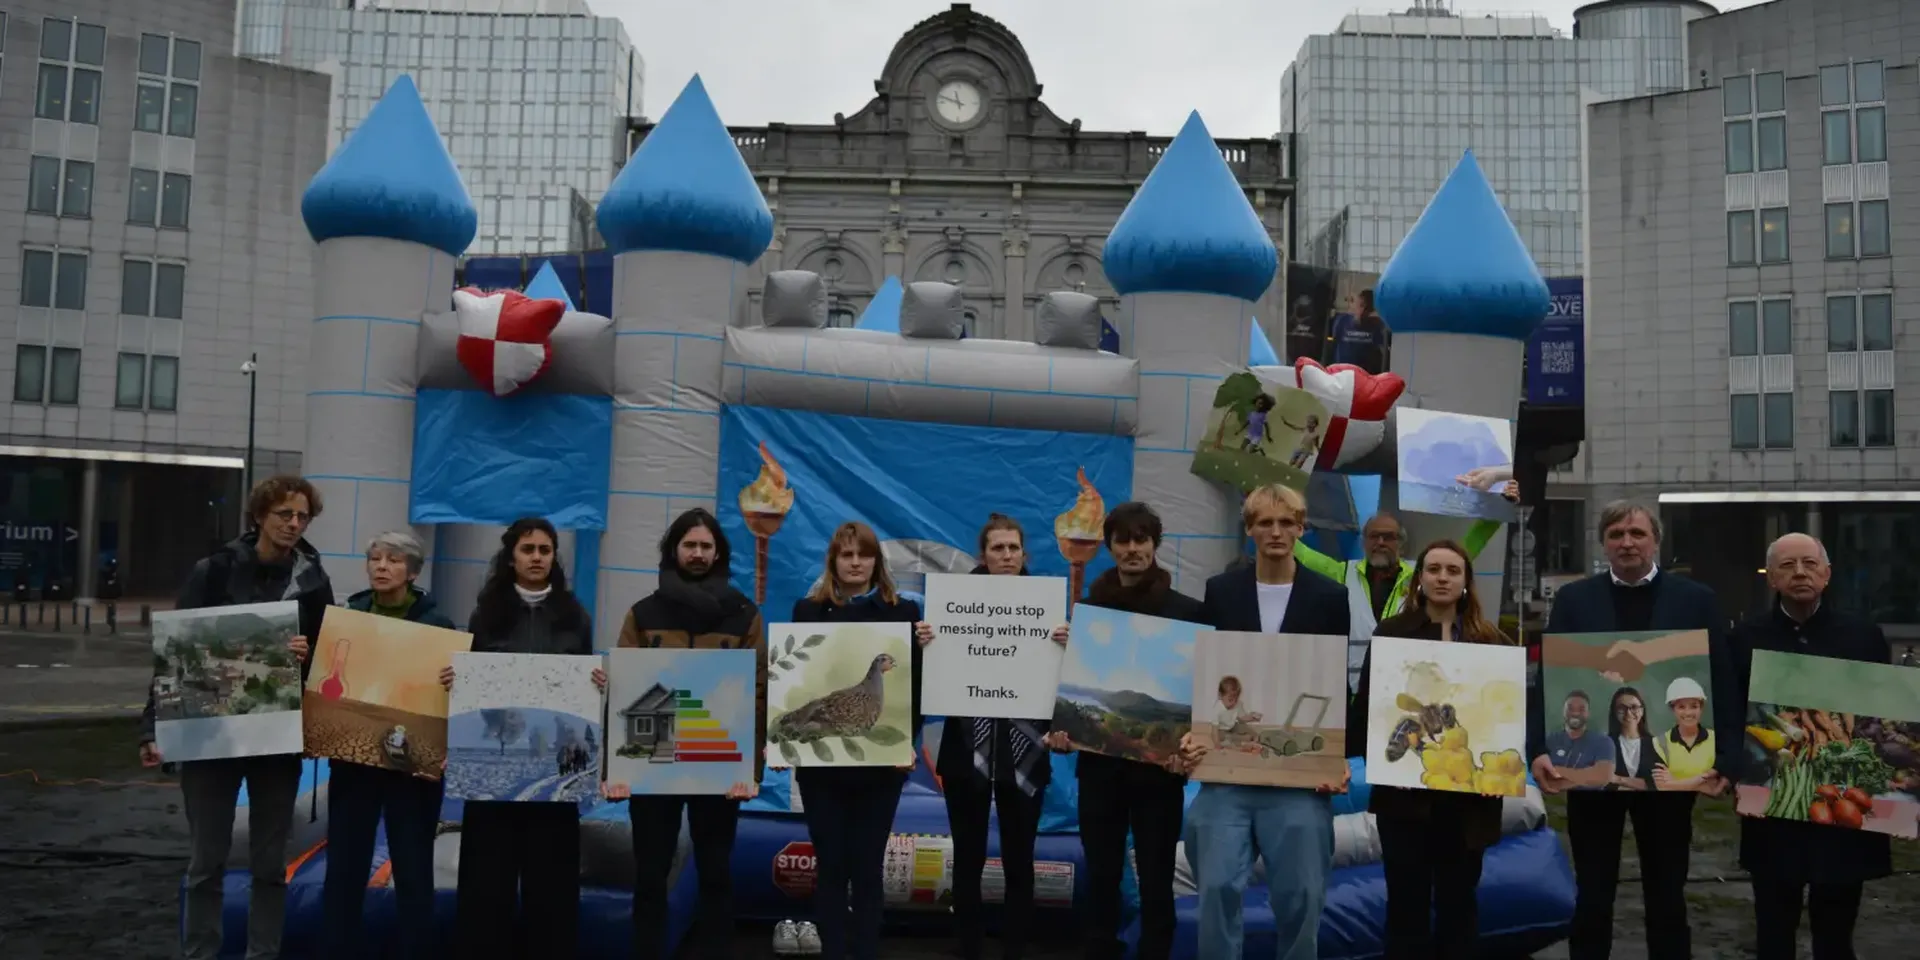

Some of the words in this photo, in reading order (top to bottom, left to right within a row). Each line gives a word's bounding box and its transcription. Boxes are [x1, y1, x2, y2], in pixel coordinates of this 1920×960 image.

[946, 602, 984, 614] Could
[988, 605, 1012, 617] you
[1015, 605, 1045, 619] stop
[940, 623, 994, 639] messing
[997, 624, 1026, 637] with
[1029, 628, 1050, 639] my
[968, 643, 1017, 657] future?
[967, 685, 1018, 699] Thanks.
